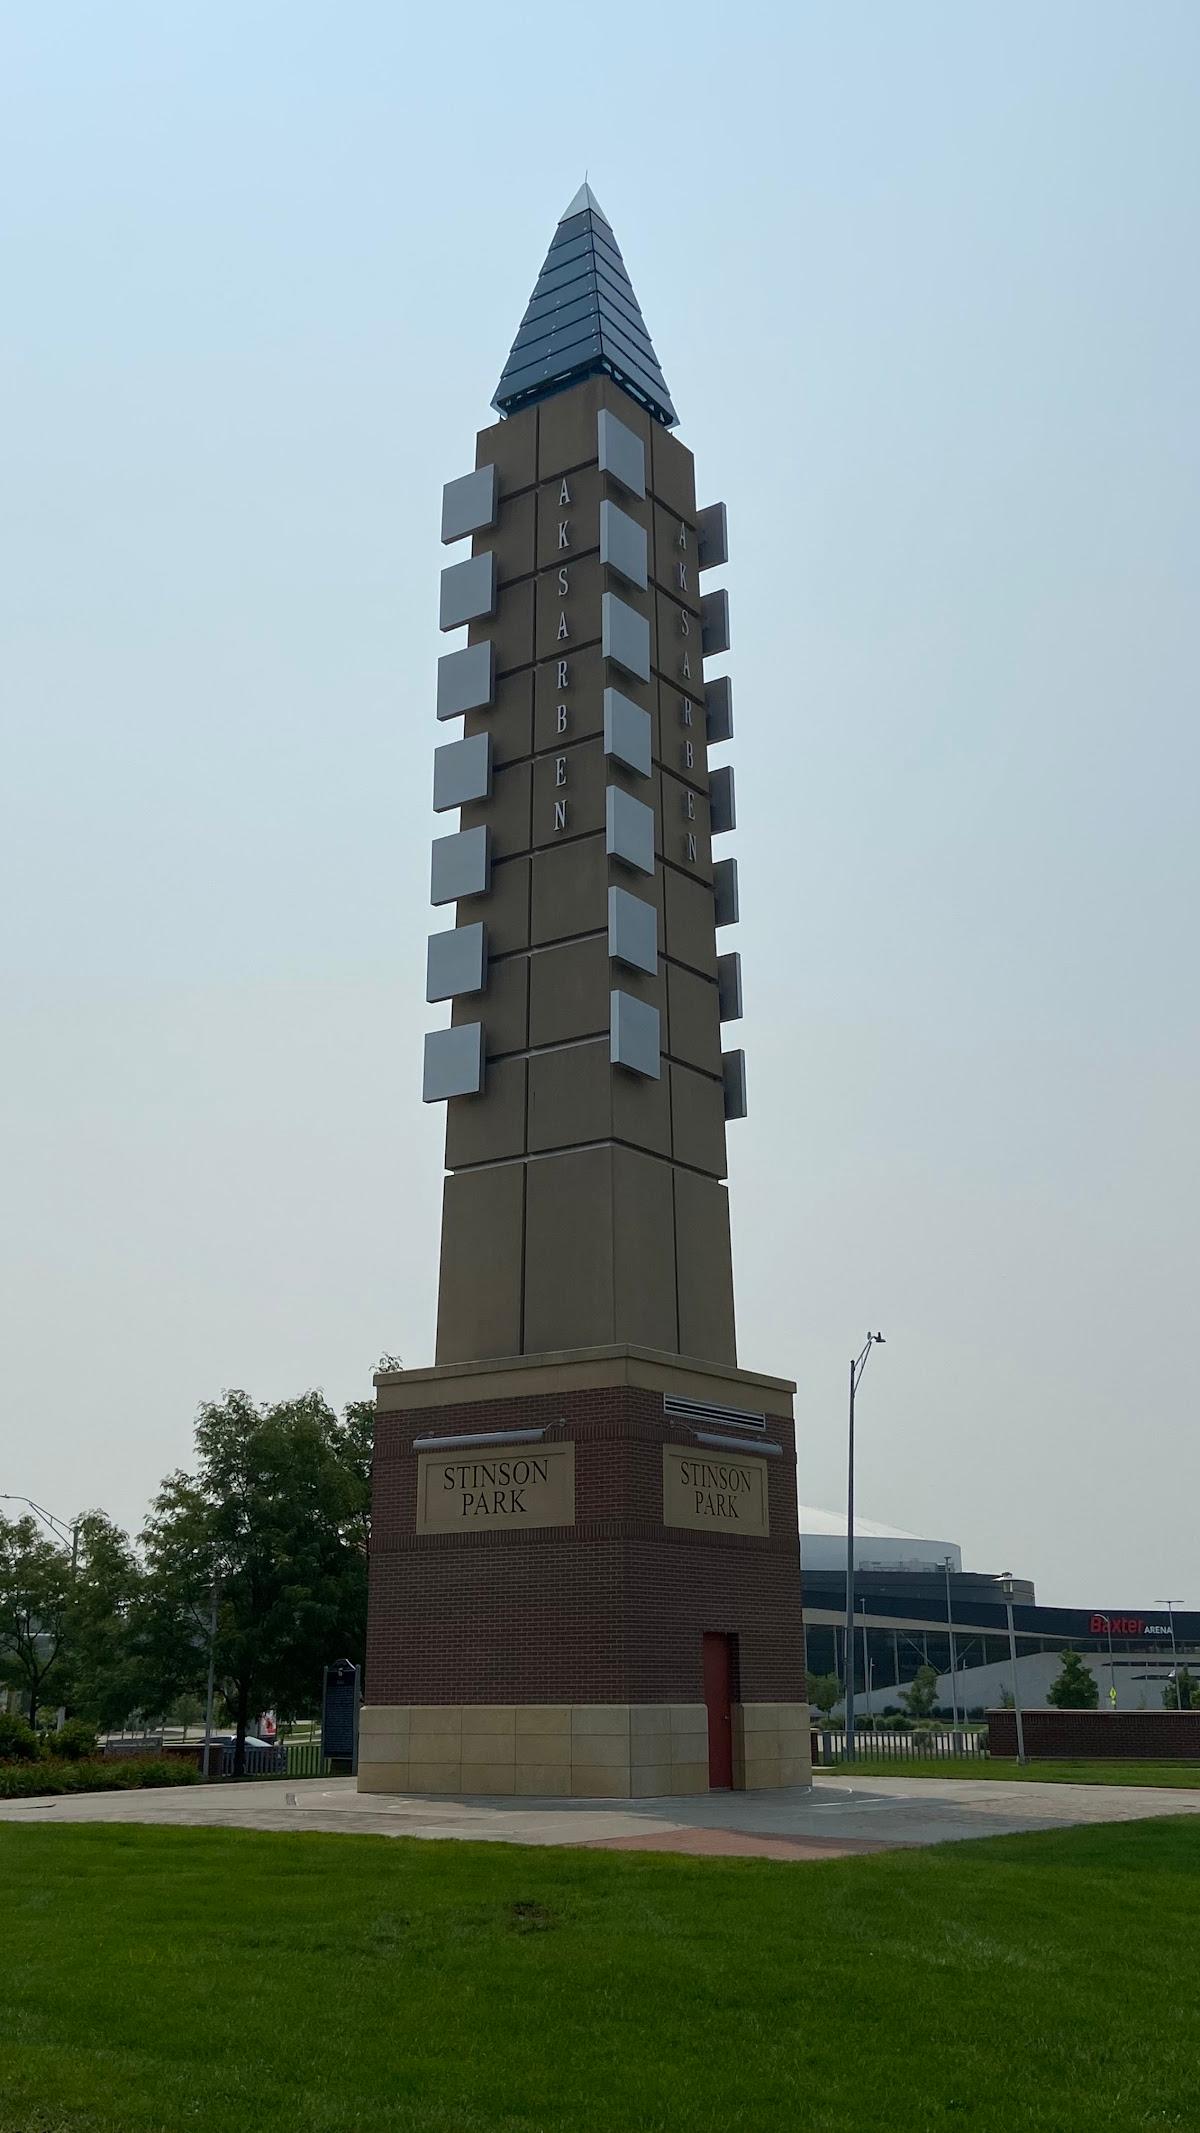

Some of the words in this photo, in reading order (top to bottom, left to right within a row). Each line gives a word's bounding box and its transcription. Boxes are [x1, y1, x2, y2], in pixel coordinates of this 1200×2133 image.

[553, 477, 571, 831] AKSARBEN
[677, 521, 697, 863] AKSARBEN
[443, 1459, 548, 1490] STINSON
[680, 1461, 752, 1493] STINSON
[462, 1489, 527, 1516] PARK
[694, 1490, 740, 1518] PARK
[1090, 1616, 1144, 1633] Baxter
[1144, 1626, 1172, 1634] ARENA
